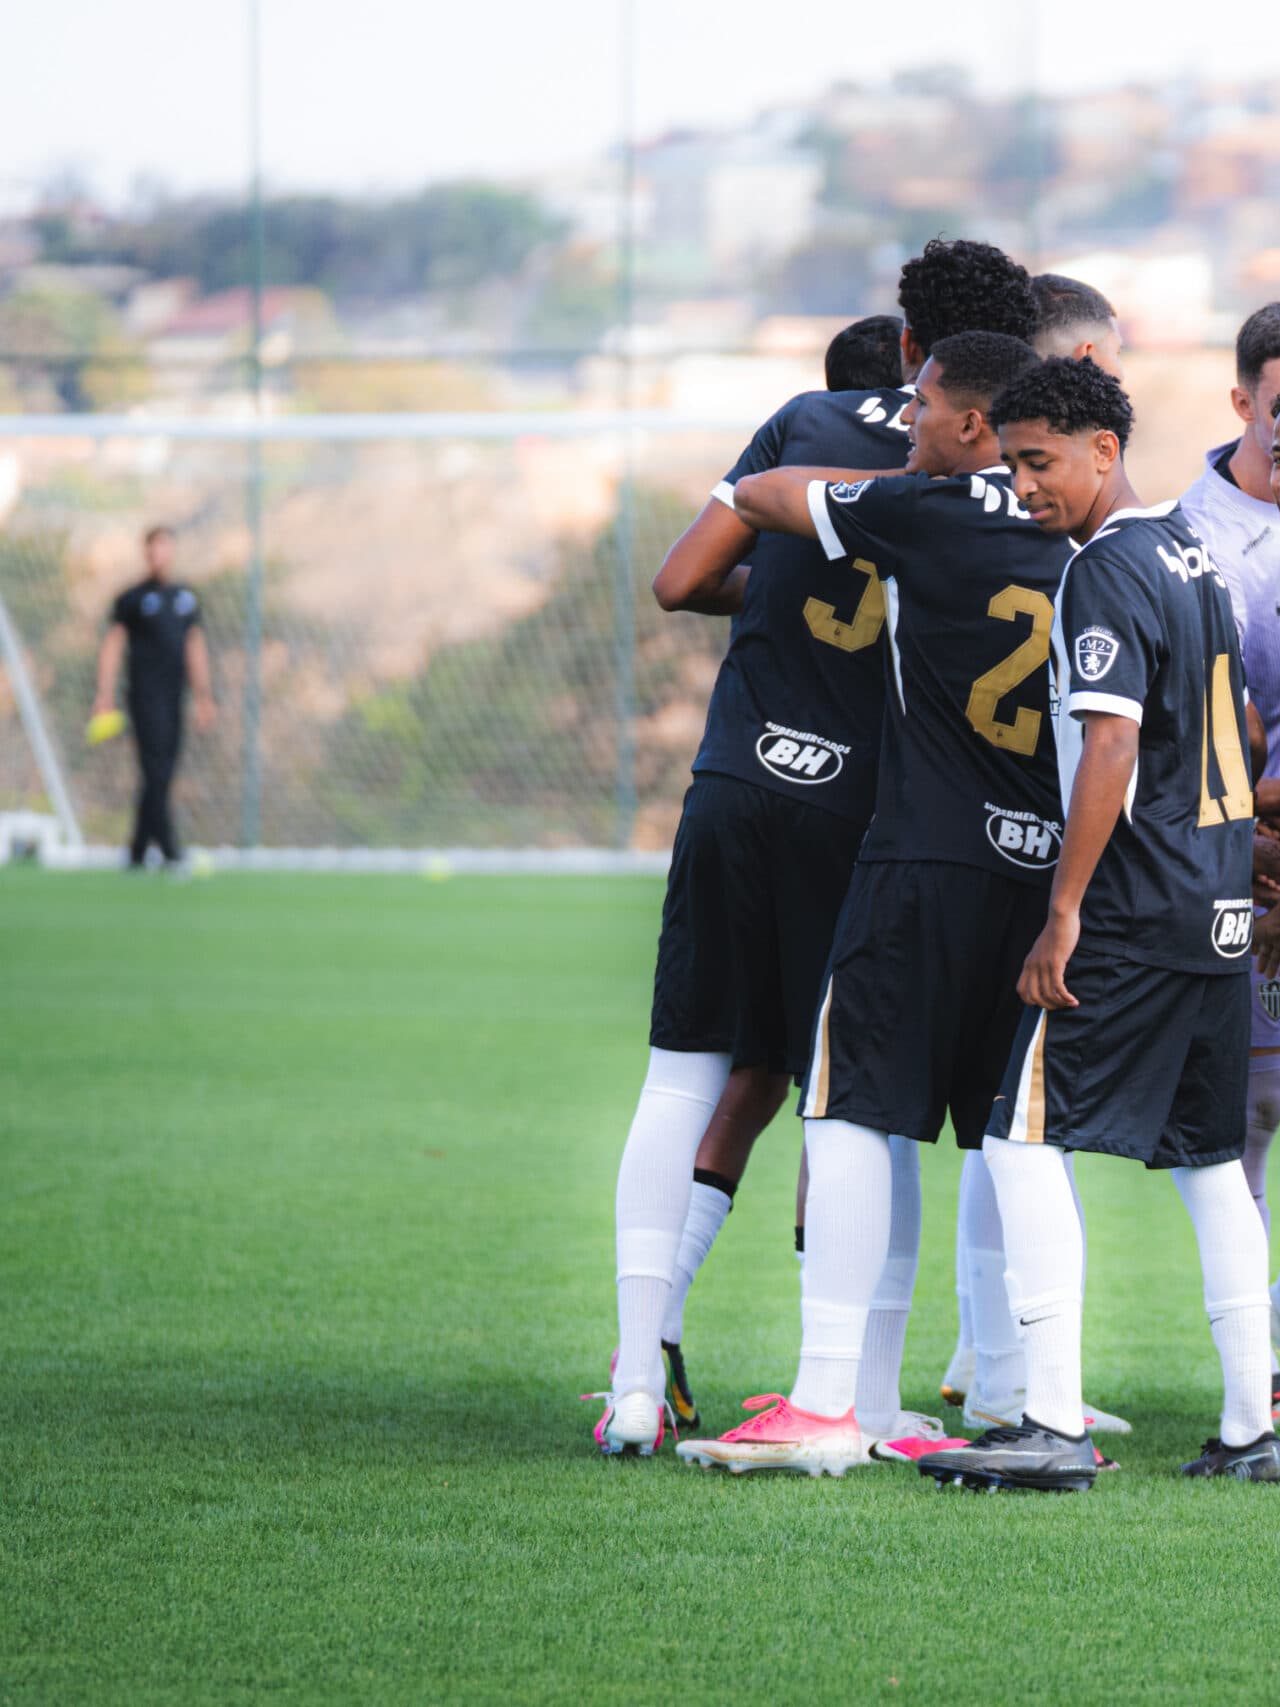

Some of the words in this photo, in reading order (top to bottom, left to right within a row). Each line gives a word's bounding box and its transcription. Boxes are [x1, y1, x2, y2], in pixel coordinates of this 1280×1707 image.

[803, 557, 886, 652] 3
[1085, 638, 1106, 651] M2
[965, 584, 1055, 757] 2
[764, 737, 832, 776] BH
[997, 818, 1052, 860] BH
[1218, 912, 1252, 946] BH
